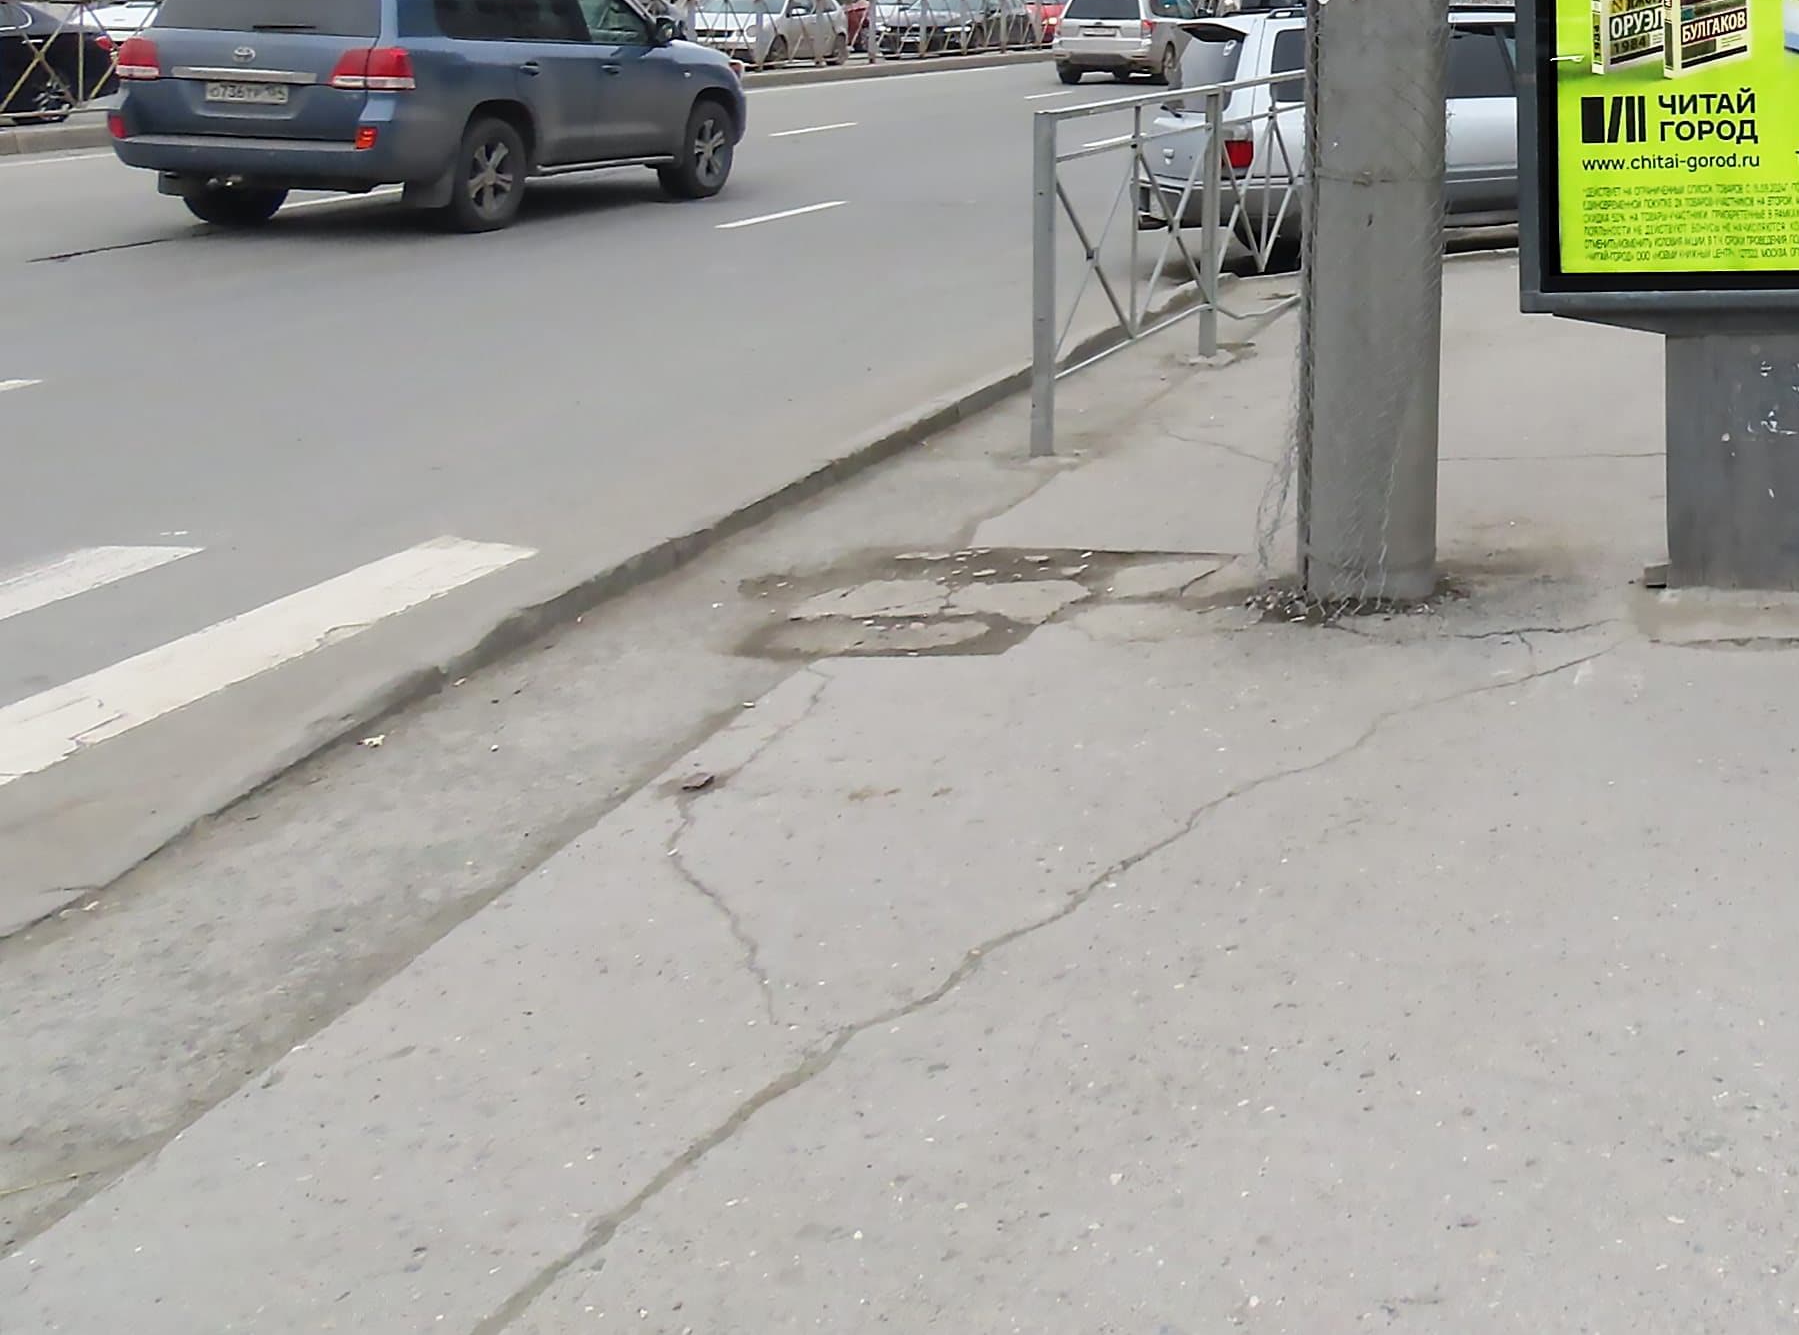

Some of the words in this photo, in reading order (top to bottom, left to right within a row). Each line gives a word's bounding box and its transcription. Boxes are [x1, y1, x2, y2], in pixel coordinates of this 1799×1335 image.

[1682, 11, 1746, 43] БУЛГАКОВ
[1613, 35, 1647, 55] 1984
[1658, 87, 1756, 115] ЧИТАЙ
[1660, 119, 1758, 144] ГОРОД
[1582, 152, 1760, 172] www.chitai-gorod.ru
